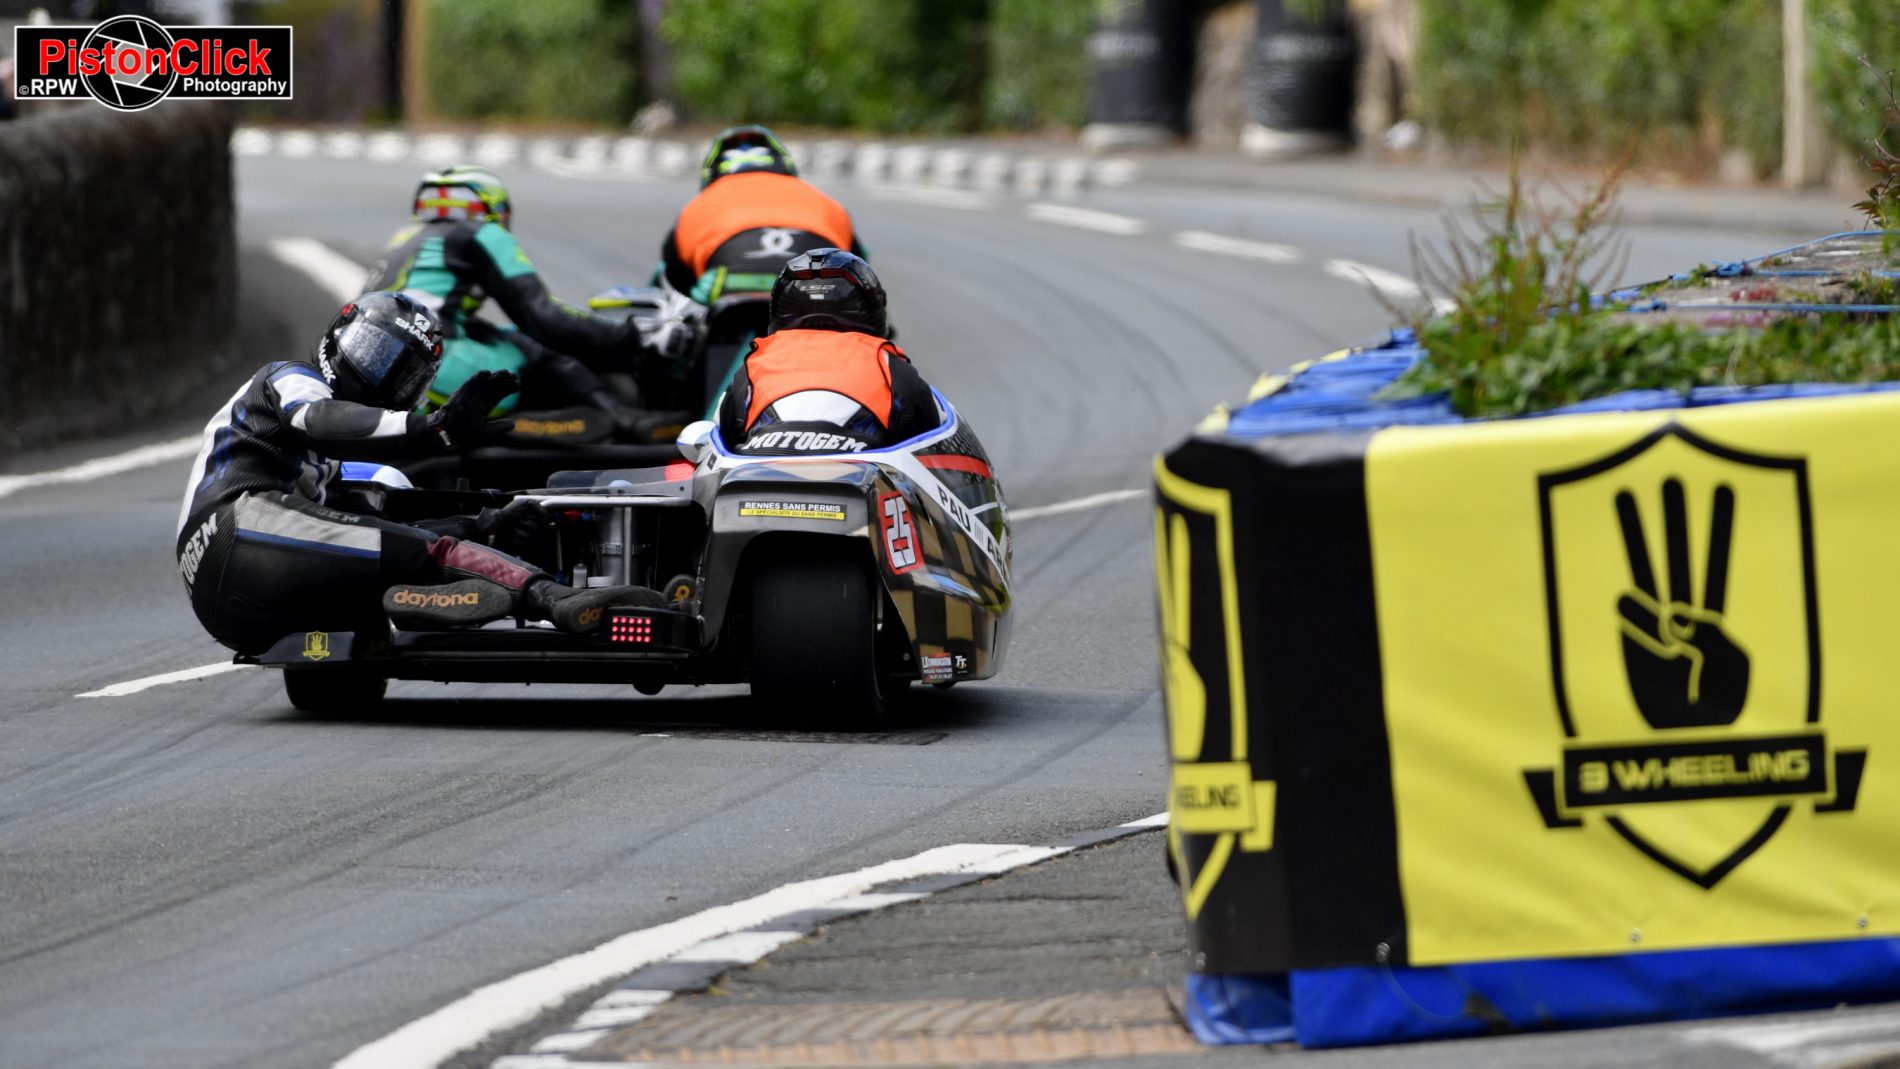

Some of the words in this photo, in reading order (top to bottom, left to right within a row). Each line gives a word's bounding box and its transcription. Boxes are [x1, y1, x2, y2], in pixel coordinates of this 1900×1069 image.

[394, 317, 434, 350] SHARK
[741, 431, 867, 452] MOTOGEM
[782, 503, 806, 511] SANS
[808, 504, 840, 512] PERMIS
[937, 484, 971, 533] PAU
[884, 496, 917, 568] 25
[393, 588, 478, 609] daytona
[1612, 748, 1811, 792] WHEELING
